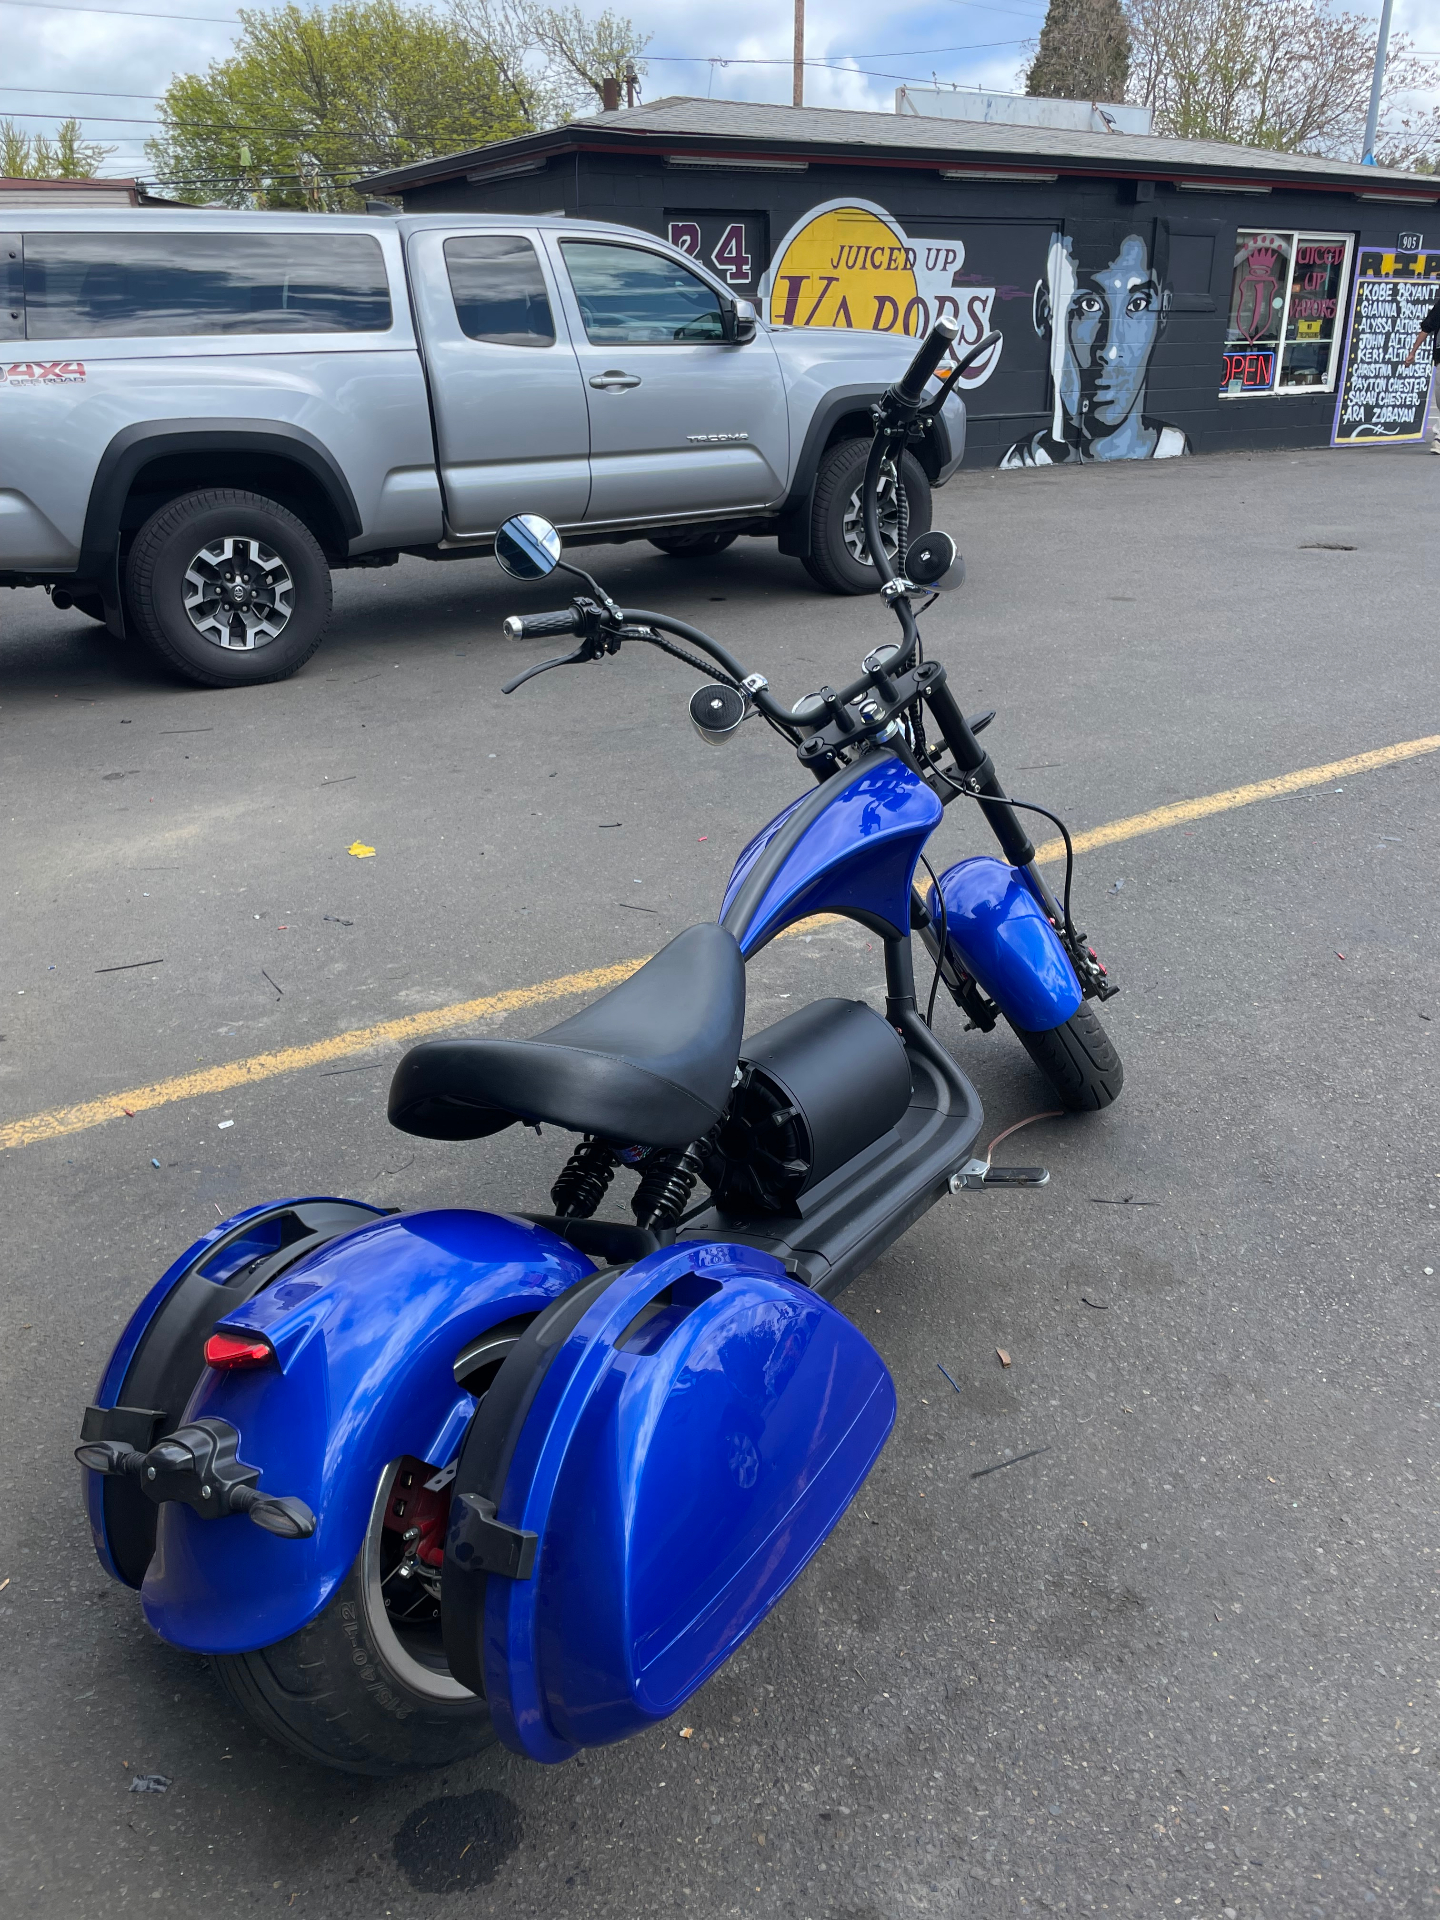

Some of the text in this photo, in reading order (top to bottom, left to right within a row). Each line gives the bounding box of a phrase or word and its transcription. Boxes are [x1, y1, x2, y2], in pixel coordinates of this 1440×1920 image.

[1402, 236, 1417, 249] 905
[668, 222, 751, 284] 24
[831, 244, 957, 272] JUICED UP
[1304, 272, 1327, 290] UP
[1362, 283, 1440, 301] KOBE BRYANT
[1359, 318, 1393, 333] ALYSSA
[1359, 333, 1386, 349] JOHN
[1396, 364, 1432, 377] MAUSER
[1351, 376, 1428, 393] PAYTON CHESTER
[1347, 391, 1420, 406] SARAH CHESTER
[1343, 406, 1416, 424] ARA ZOBAYAN
